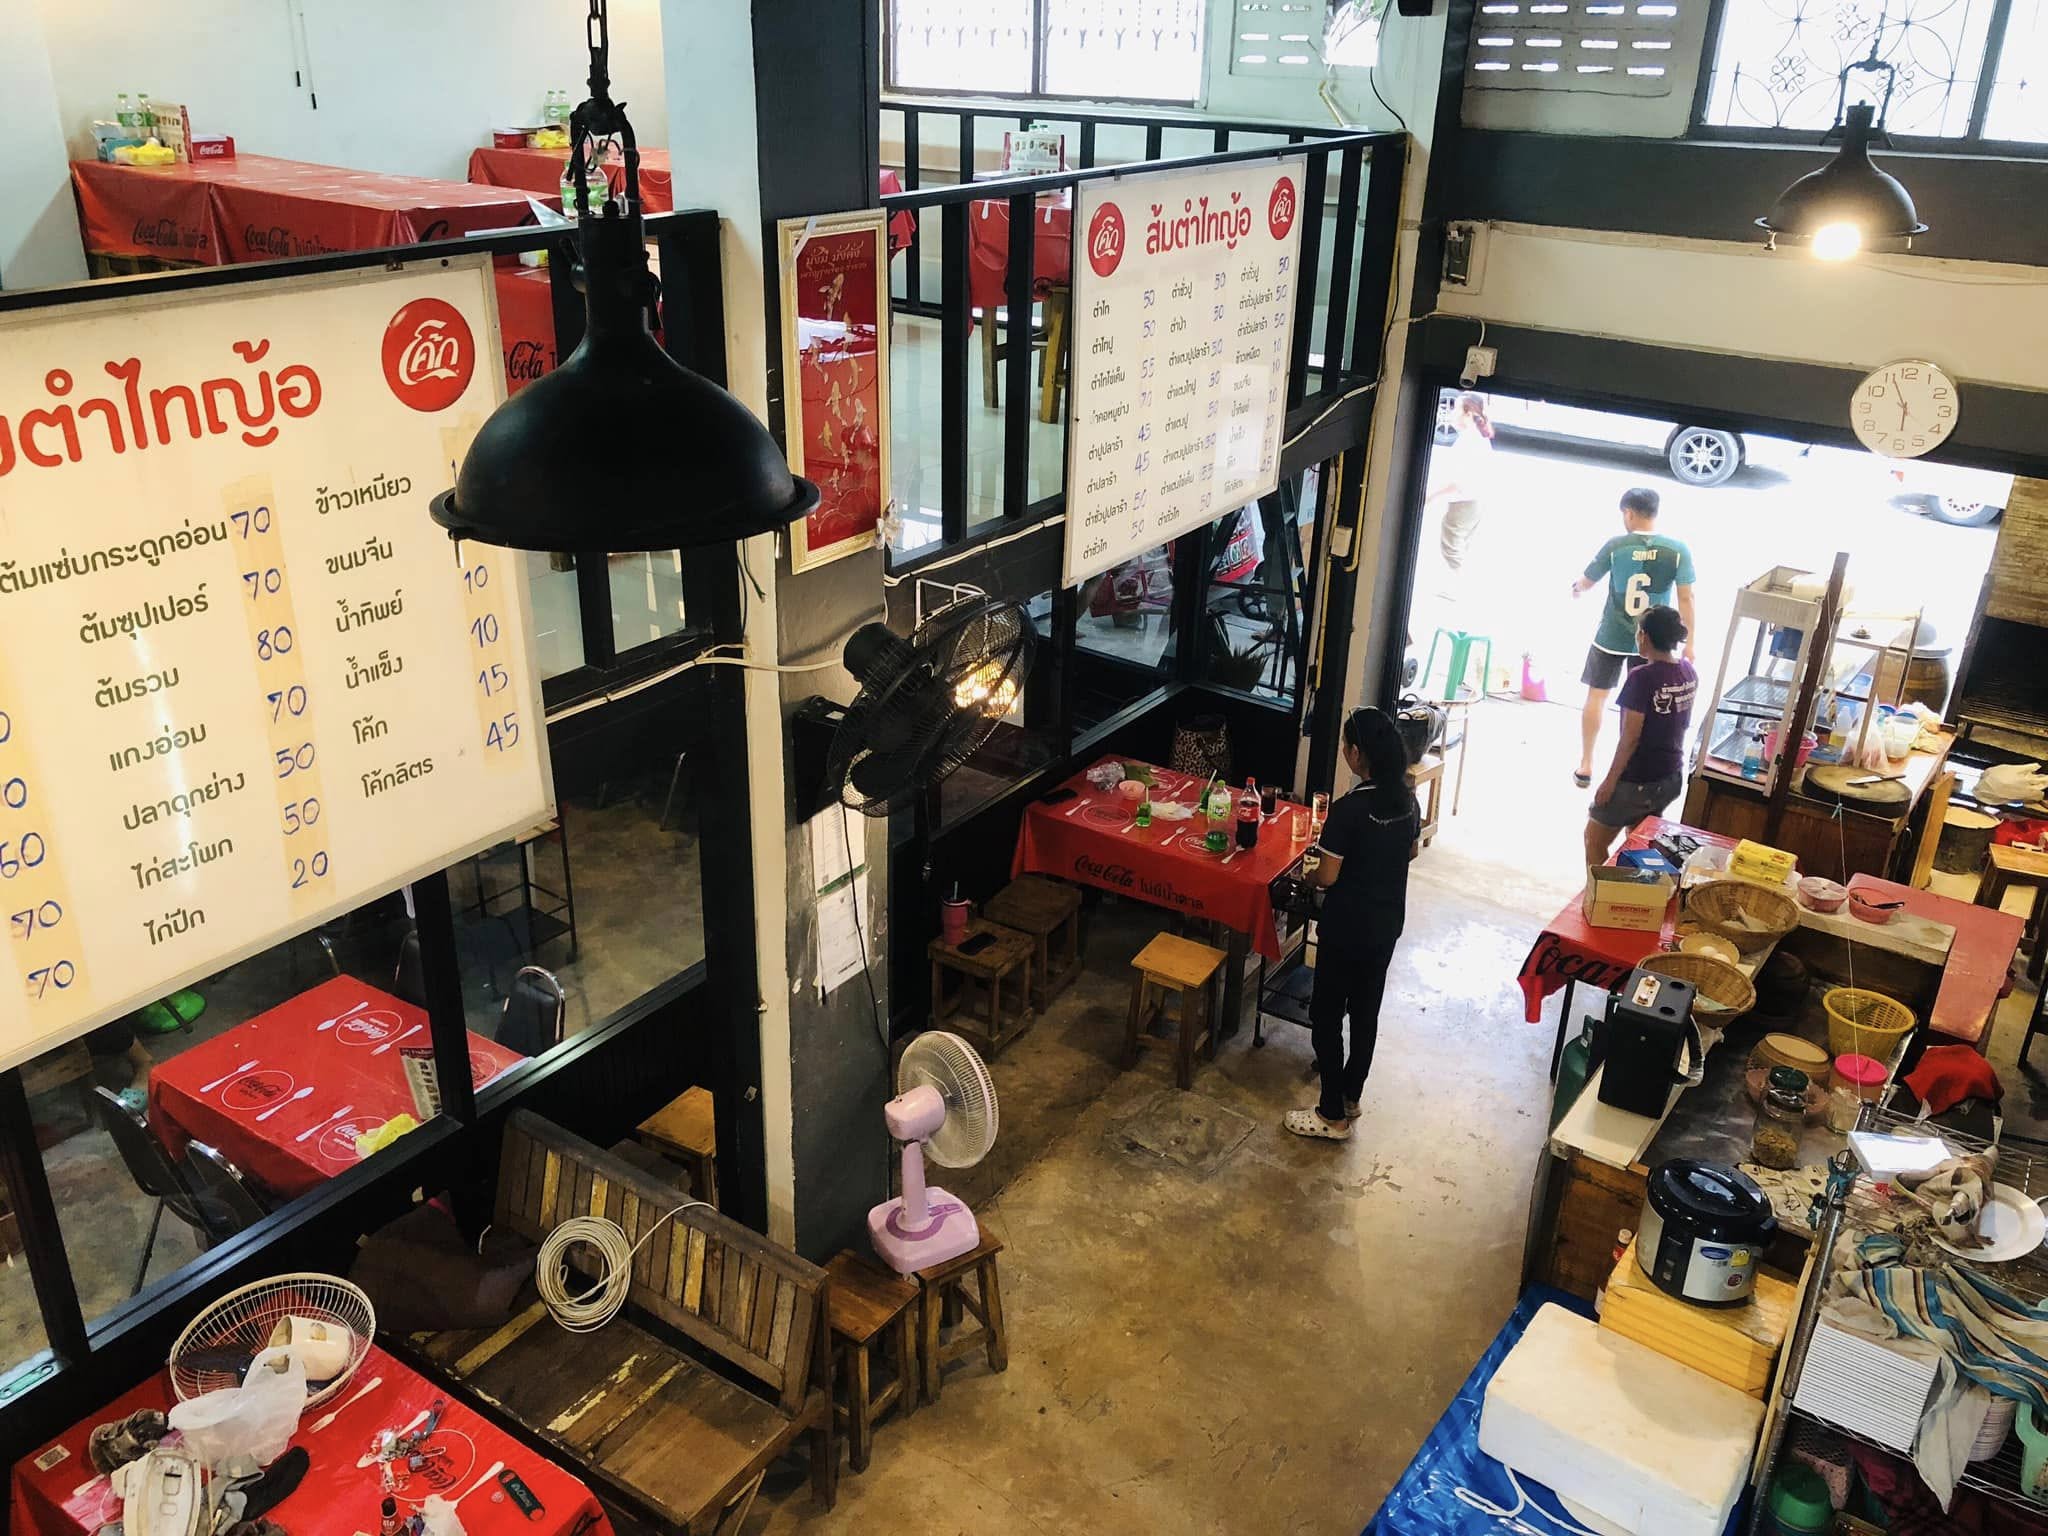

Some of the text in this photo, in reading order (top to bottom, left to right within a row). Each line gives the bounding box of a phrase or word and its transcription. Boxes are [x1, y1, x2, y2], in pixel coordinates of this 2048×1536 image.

[1146, 192, 1251, 255] ส้มตำไทญ้อ
[1143, 289, 1155, 309] 50
[1143, 320, 1156, 338] 50
[1868, 385, 1885, 398] 10
[1901, 368, 1919, 380] 12
[1933, 388, 1948, 400] 2
[1859, 402, 1872, 414] 9
[1864, 419, 1876, 432] 8
[1937, 405, 1952, 418] 3
[1138, 423, 1151, 442] 45
[1875, 433, 1888, 445] 7
[1893, 438, 1905, 451] 6
[1912, 435, 1925, 447] 5
[1928, 424, 1941, 435] 4
[1135, 451, 1150, 476] 45
[315, 473, 412, 515] ข้าวเหนียว
[0, 506, 271, 593] ต้มแซ่บกระดูกอ่อน 70
[325, 536, 393, 575] ขนมจีน
[79, 568, 281, 643] ต้มซุปเปอร์ 70
[335, 565, 488, 633] น้ำทิพย์ 10
[1625, 572, 1652, 617] 6
[94, 626, 293, 708] ต้มรวม 80
[345, 614, 498, 689] น้ำแข็ง 10
[352, 664, 509, 744] โค้ก 15
[109, 685, 307, 771] แกงอ่อม 70
[361, 712, 519, 798] โค้กลิตร 45
[122, 743, 315, 830] ปลาดุกย่าง 50
[131, 798, 321, 889] ไก่สะโพก 50
[143, 851, 329, 945] ไก่ปีก 20
[11, 900, 62, 941] 70
[28, 960, 75, 1000] 70
